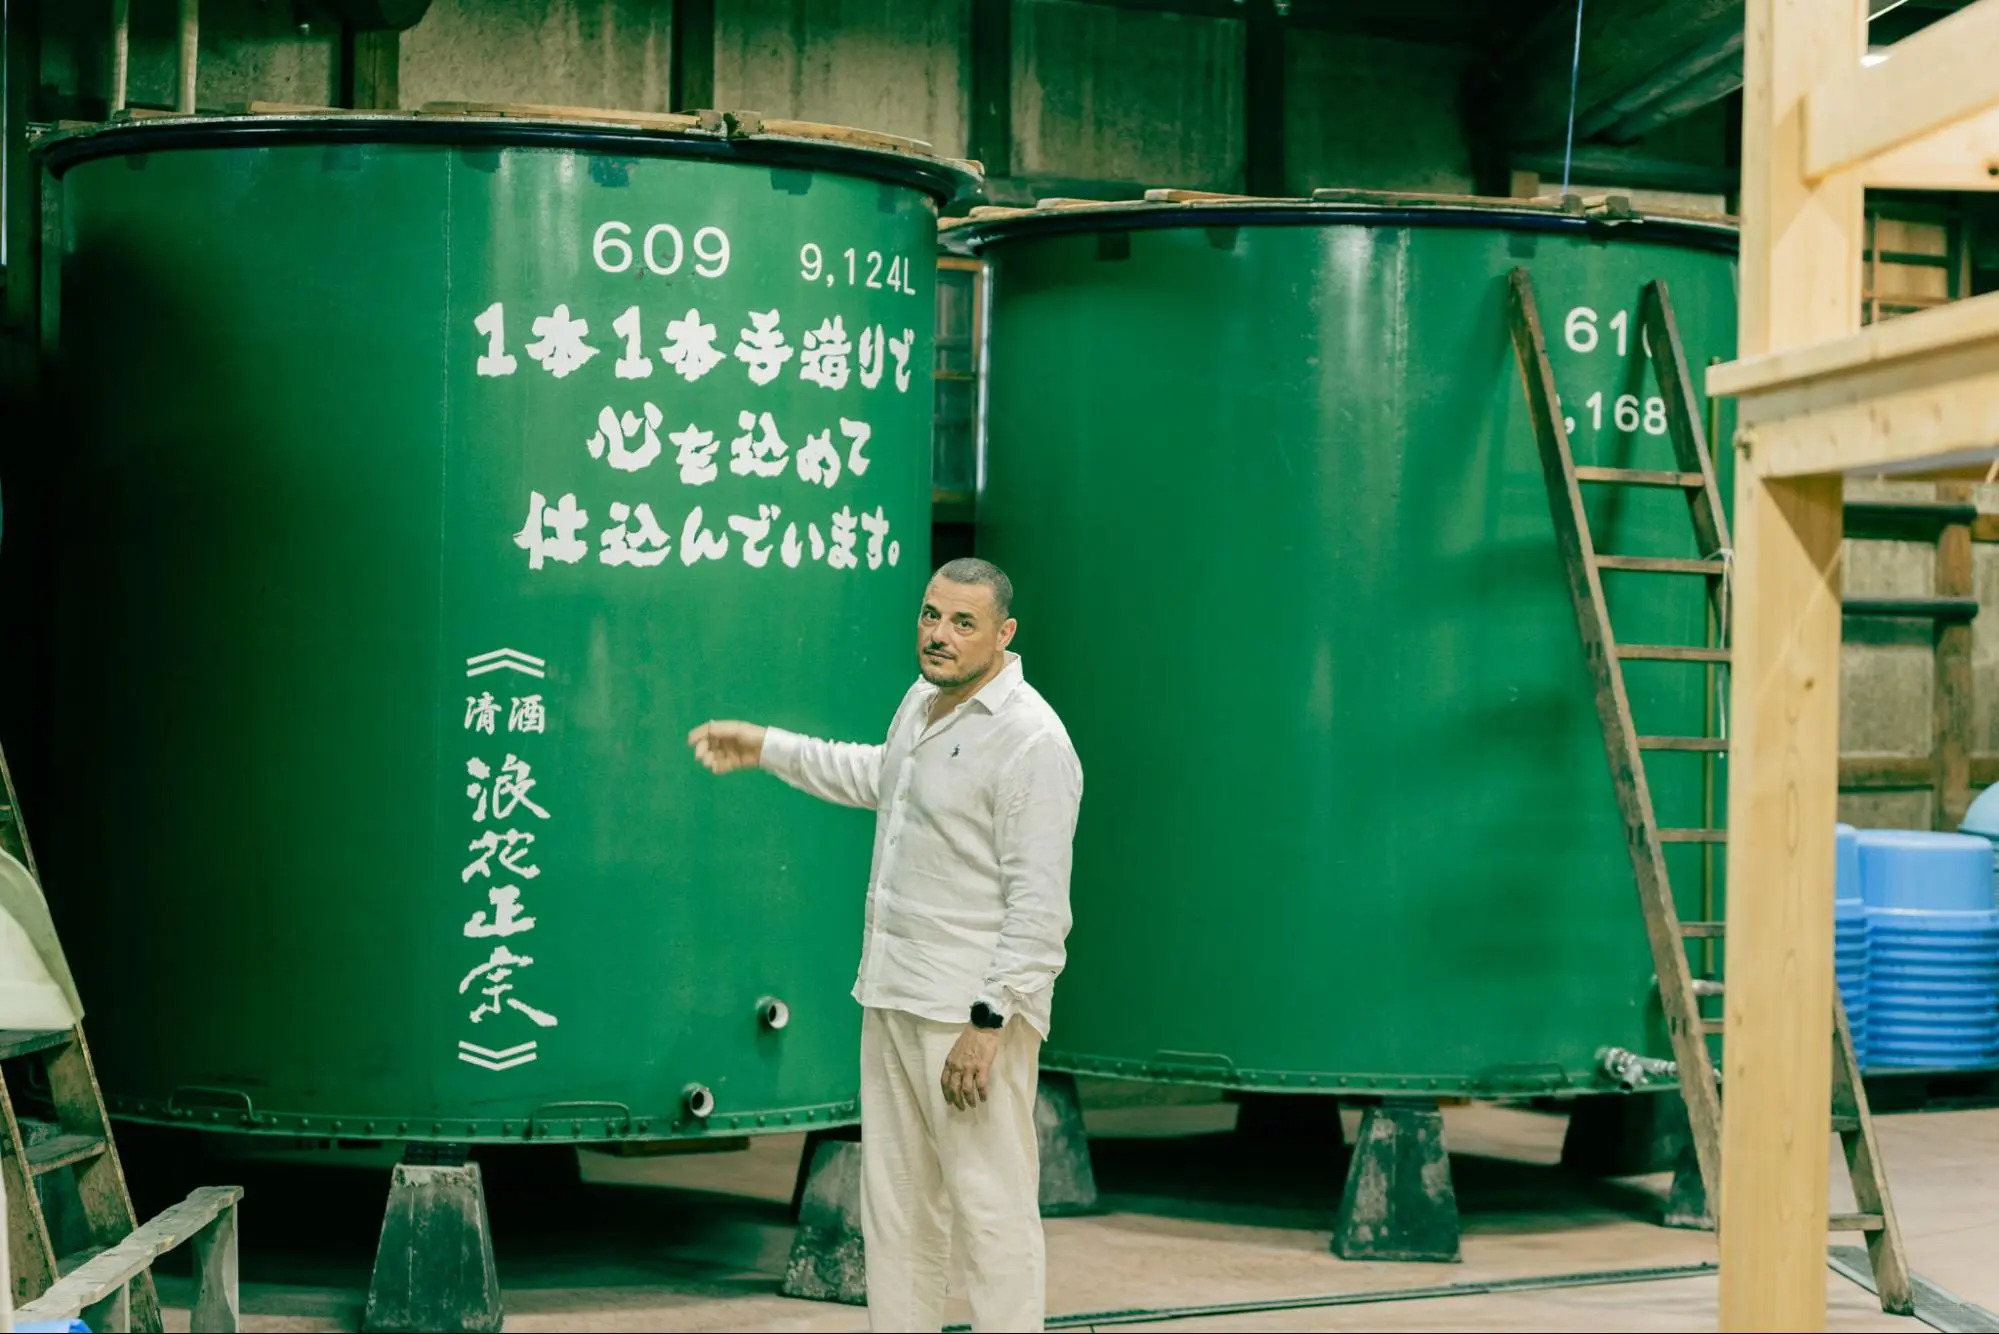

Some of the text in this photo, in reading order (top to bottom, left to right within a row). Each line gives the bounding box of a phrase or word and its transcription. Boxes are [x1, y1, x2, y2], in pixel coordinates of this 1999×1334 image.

[592, 220, 731, 279] 609
[799, 242, 916, 296] 9,124L
[473, 302, 915, 393] 1本1本手造りで
[1564, 306, 1652, 358] 61
[1556, 391, 1668, 436] ,168
[586, 400, 871, 489] 心を込めて
[513, 490, 900, 570] 仕込んでいます。
[464, 691, 545, 735] 清酒
